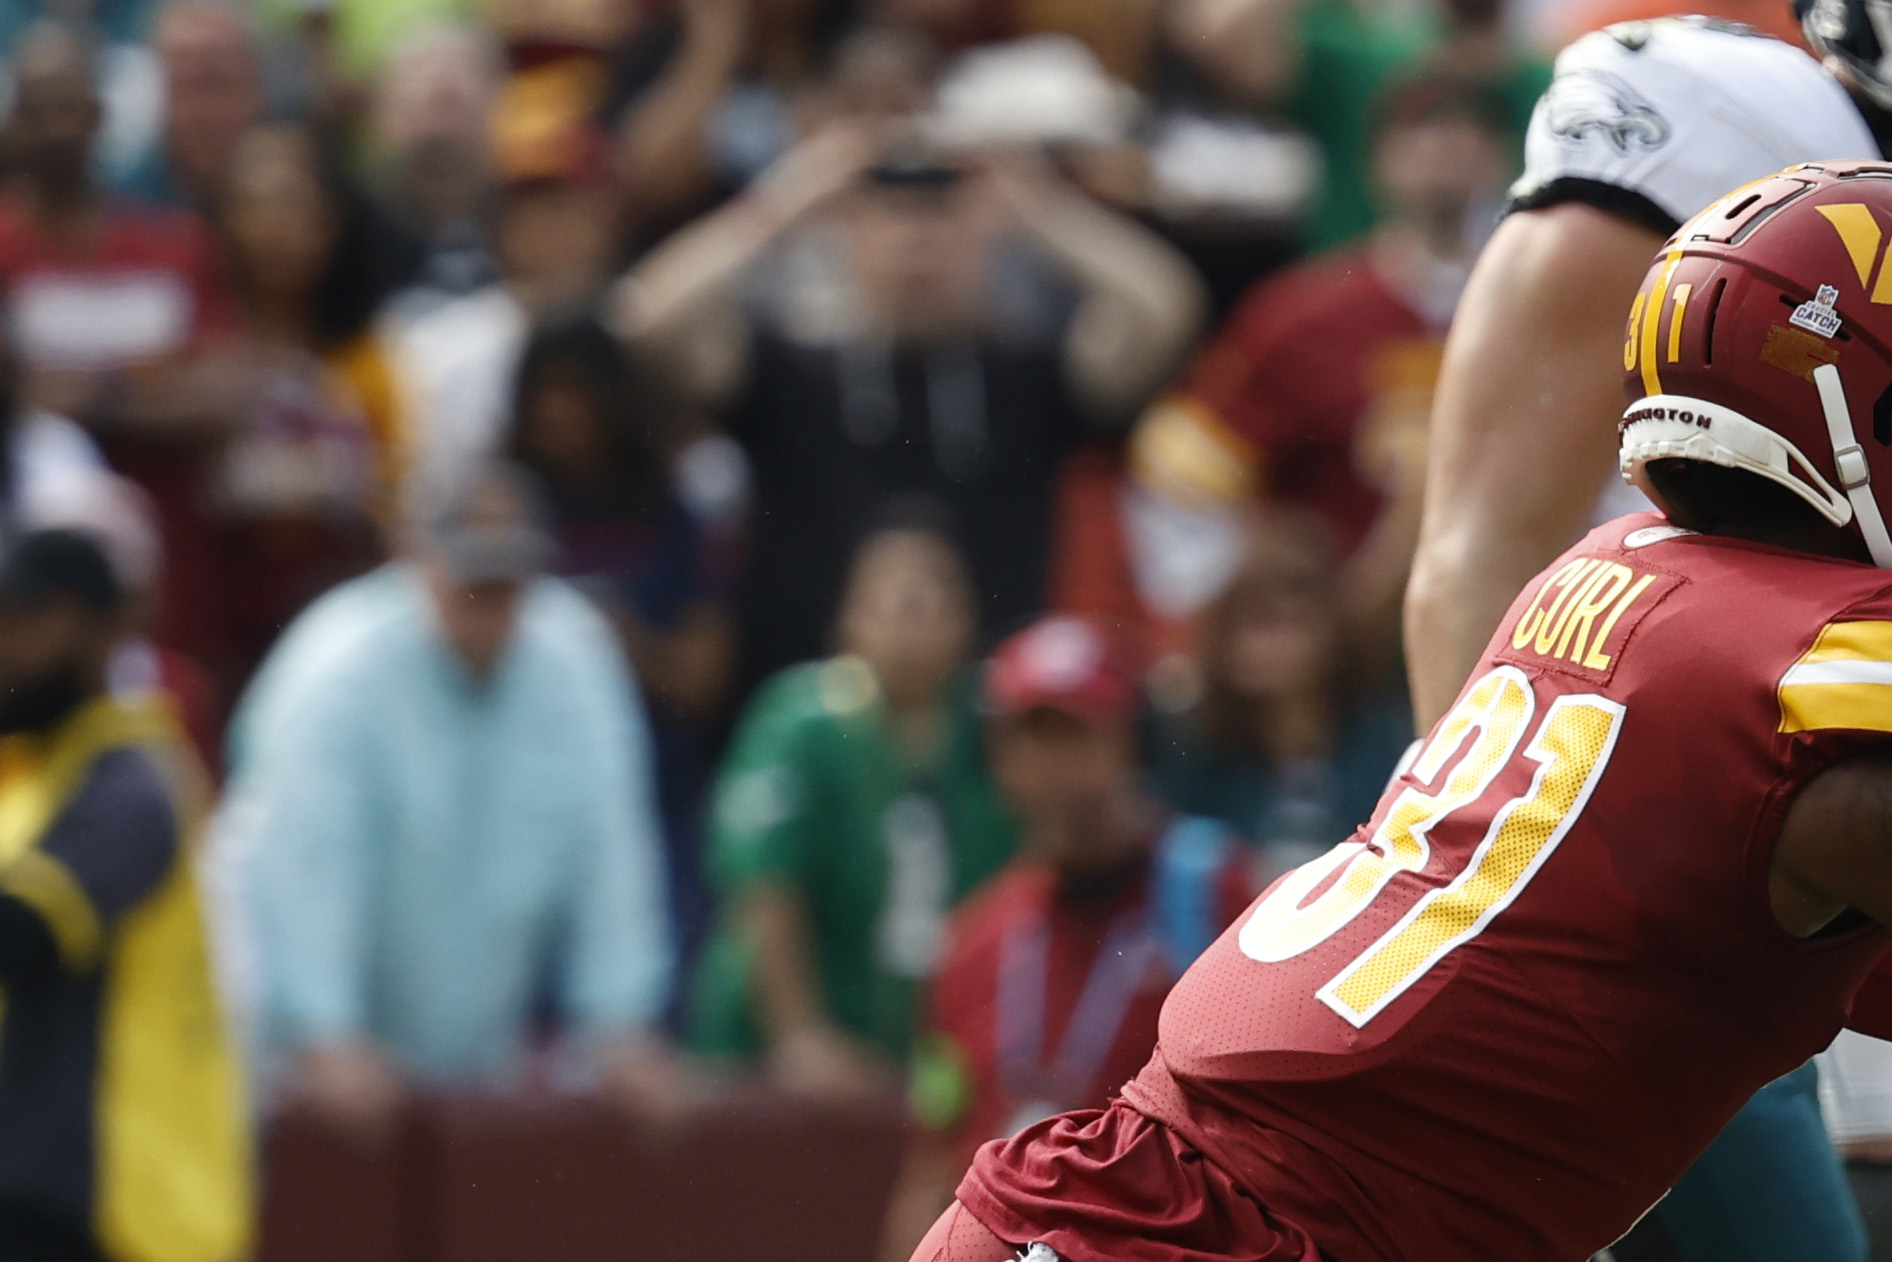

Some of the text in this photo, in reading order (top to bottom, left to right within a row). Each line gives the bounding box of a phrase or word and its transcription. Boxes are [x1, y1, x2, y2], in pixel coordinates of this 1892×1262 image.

[1623, 284, 1692, 371] 31
[1796, 307, 1838, 331] CATCH
[1511, 557, 1657, 671] CURL
[1238, 665, 1626, 1028] 31
